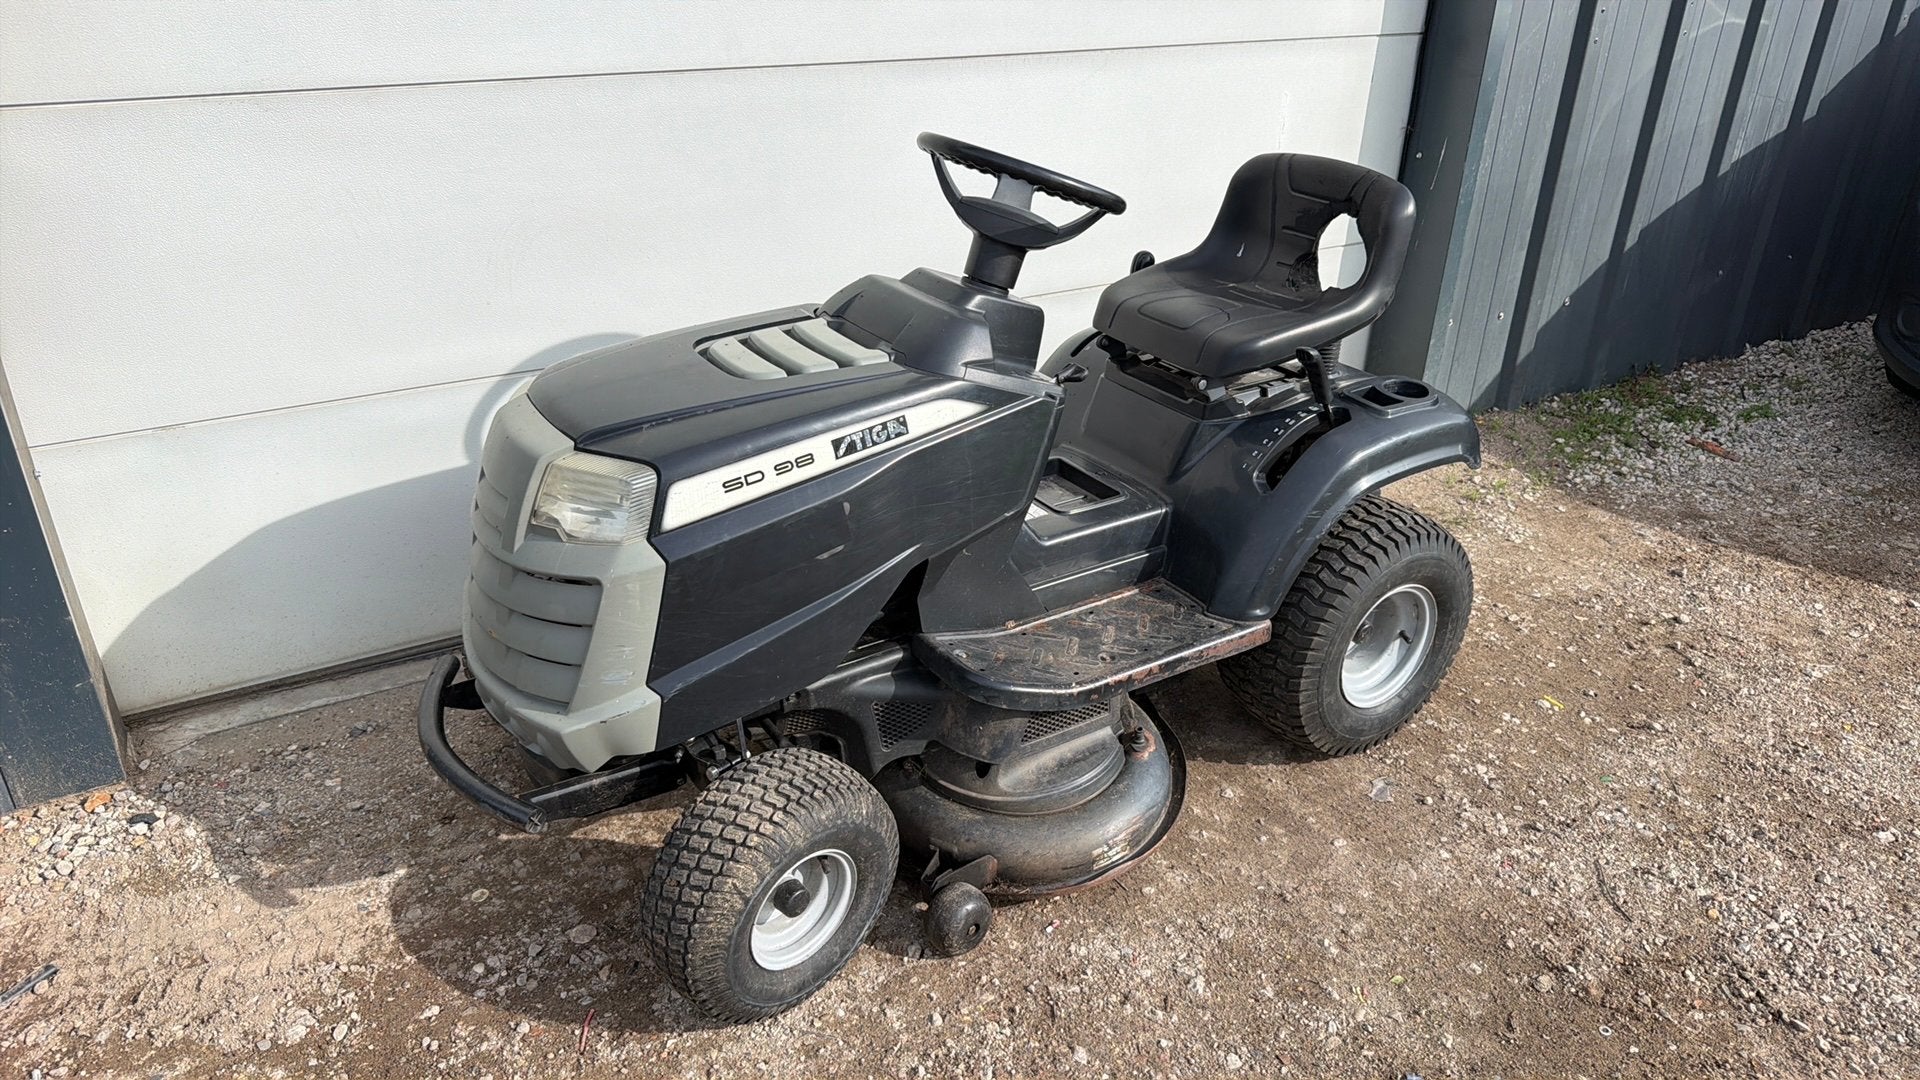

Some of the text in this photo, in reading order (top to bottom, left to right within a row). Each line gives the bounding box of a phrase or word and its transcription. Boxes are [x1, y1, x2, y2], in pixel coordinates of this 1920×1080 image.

[835, 416, 908, 459] STIGA
[722, 453, 815, 494] SD 98
